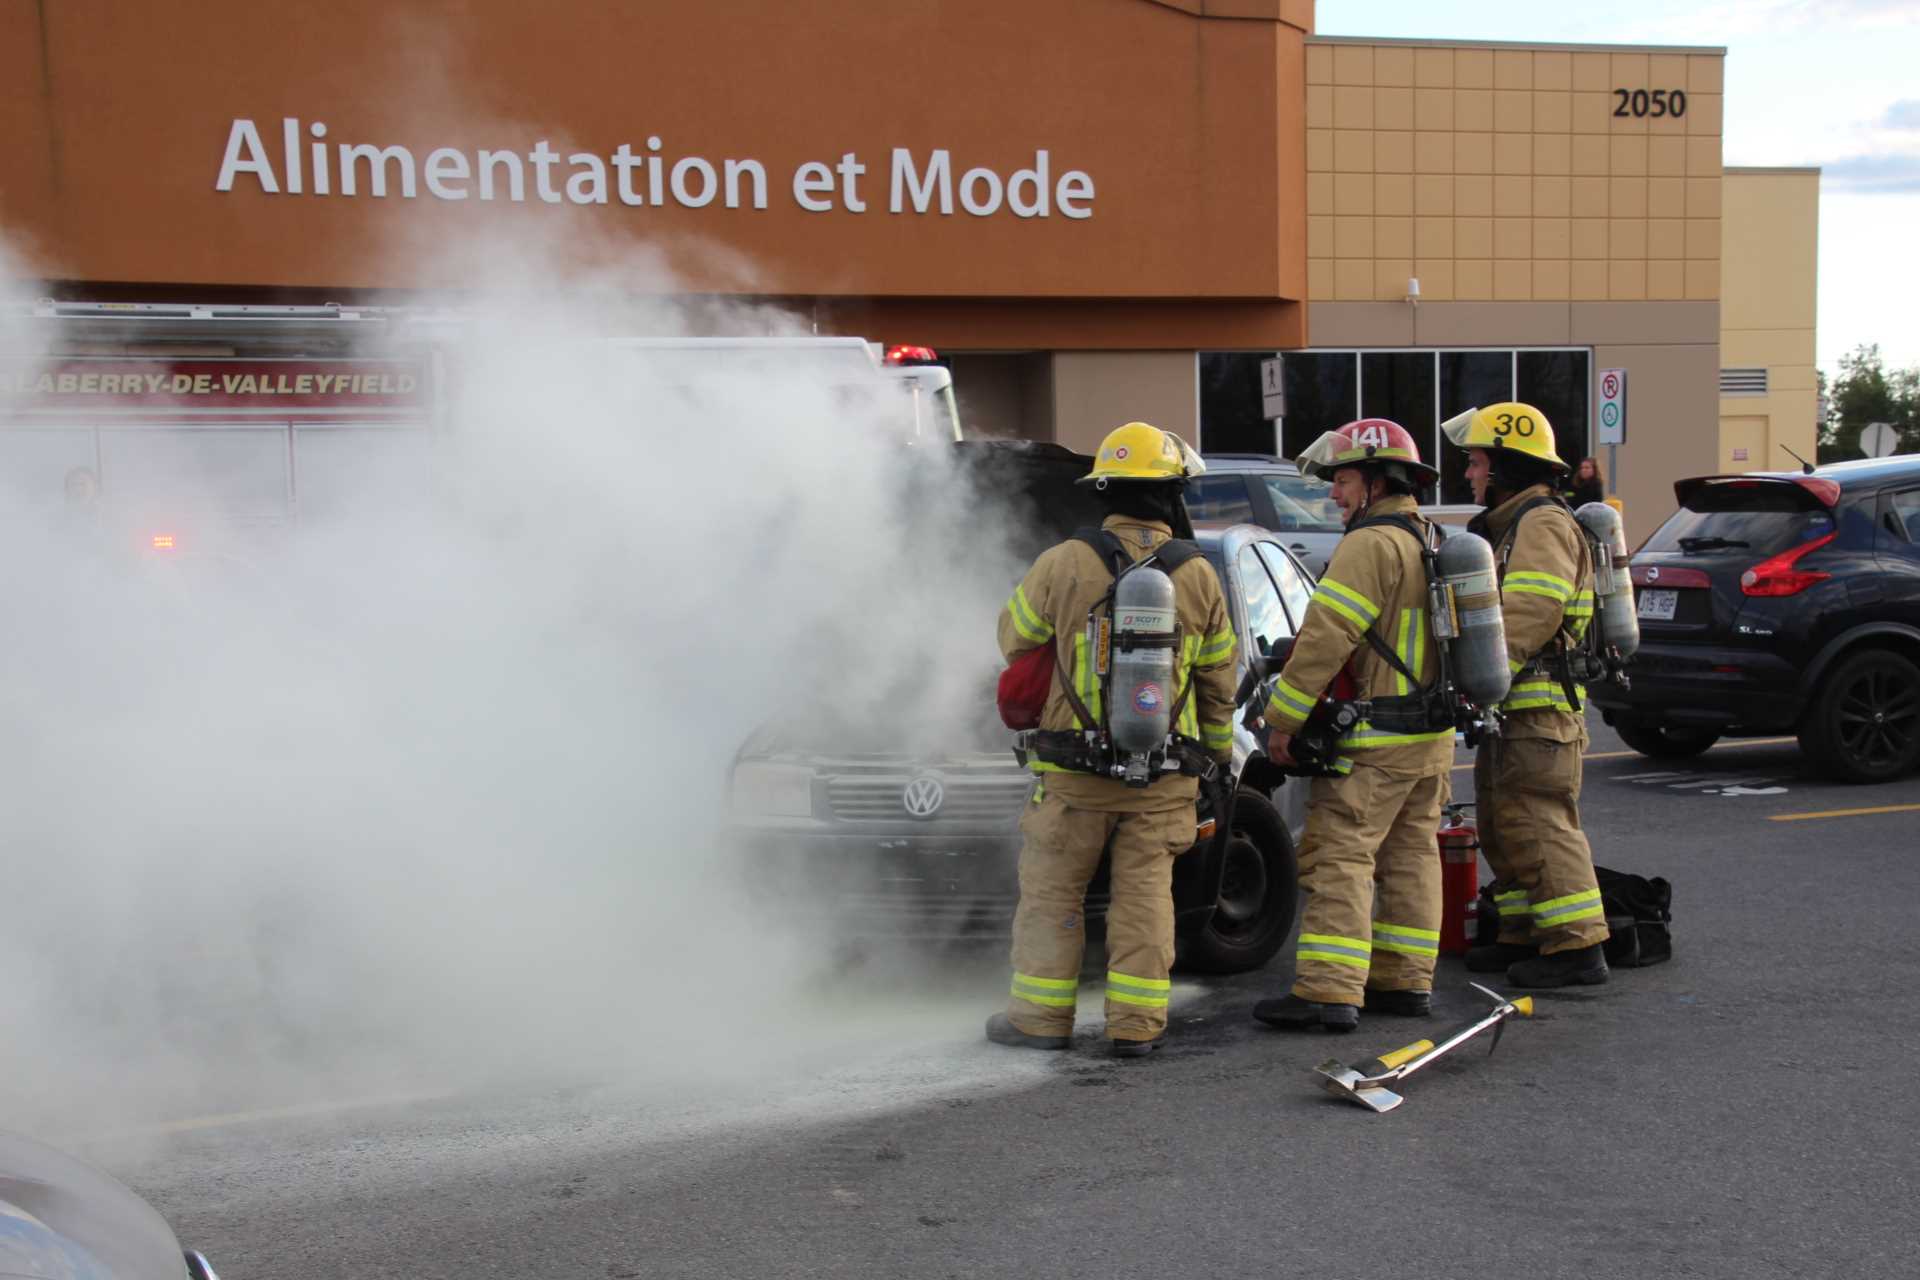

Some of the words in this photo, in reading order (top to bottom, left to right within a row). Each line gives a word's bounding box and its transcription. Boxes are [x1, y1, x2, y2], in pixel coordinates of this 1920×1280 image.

[1613, 88, 1687, 118] 2050
[215, 117, 769, 210] Alimentation
[792, 152, 868, 213] et
[889, 147, 1095, 220] Mode
[0, 373, 417, 395] LABERRY-DE-VALLEYFIELD
[1351, 425, 1389, 449] 141
[1493, 413, 1536, 438] 30
[1134, 615, 1163, 624] SCOTT
